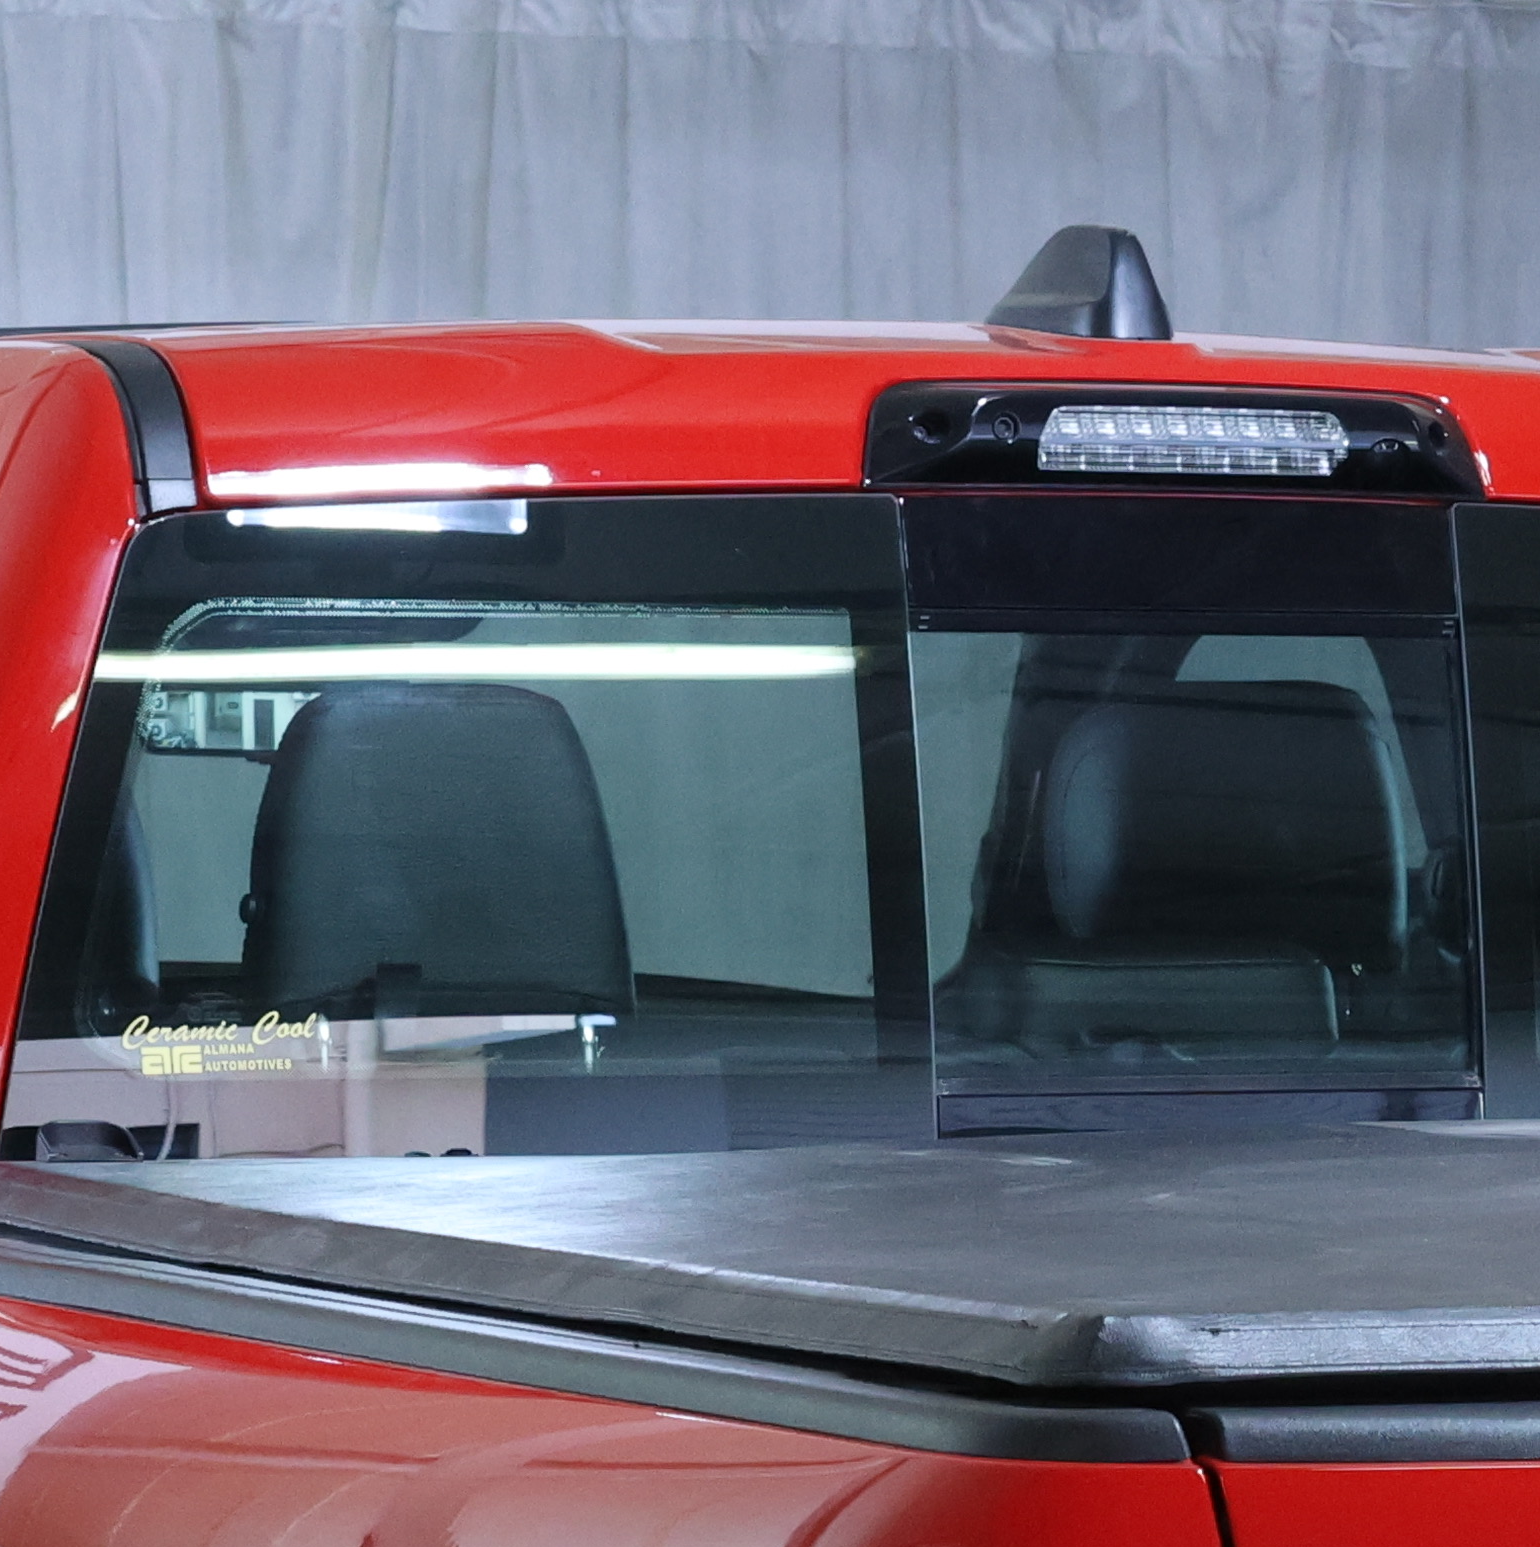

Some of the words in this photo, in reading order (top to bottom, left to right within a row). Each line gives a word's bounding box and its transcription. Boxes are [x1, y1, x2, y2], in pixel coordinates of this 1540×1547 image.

[122, 1015, 238, 1050] Ceramic
[252, 1010, 317, 1045] Cool
[203, 1044, 254, 1055] ALMANA
[205, 1058, 292, 1072] AUTOMOTIVES
